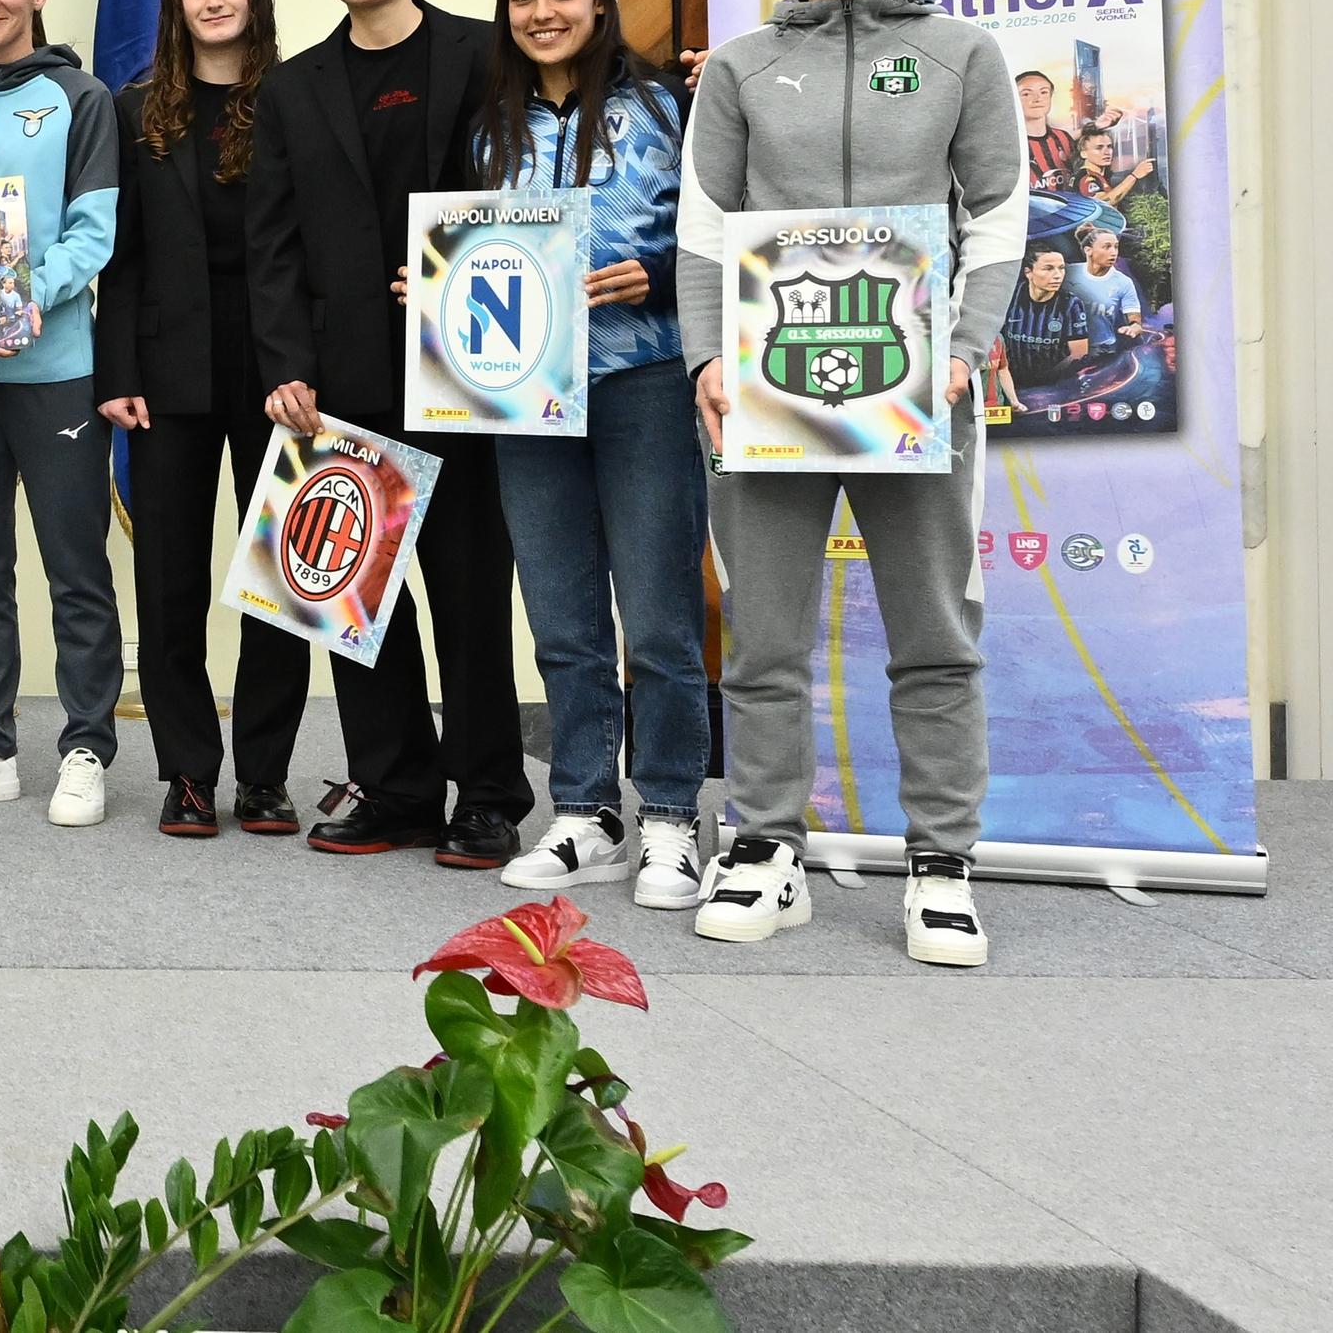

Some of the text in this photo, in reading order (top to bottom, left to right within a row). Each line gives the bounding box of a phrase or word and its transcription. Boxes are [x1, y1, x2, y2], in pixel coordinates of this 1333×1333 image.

[1006, 12, 1076, 28] 2025-2026
[1095, 13, 1137, 21] WOMEN
[437, 207, 560, 225] NAPOLI WOMEN
[776, 226, 892, 246] SASSUOLO
[471, 258, 523, 270] NAPOLI
[470, 361, 521, 372] WOMEN
[435, 409, 468, 417] PANINI
[329, 436, 381, 466] MILAN
[761, 446, 800, 454] PANINI
[315, 479, 360, 512] ACM
[1016, 538, 1040, 549] LND
[294, 563, 332, 588] 1899
[250, 593, 278, 611] PANINI
